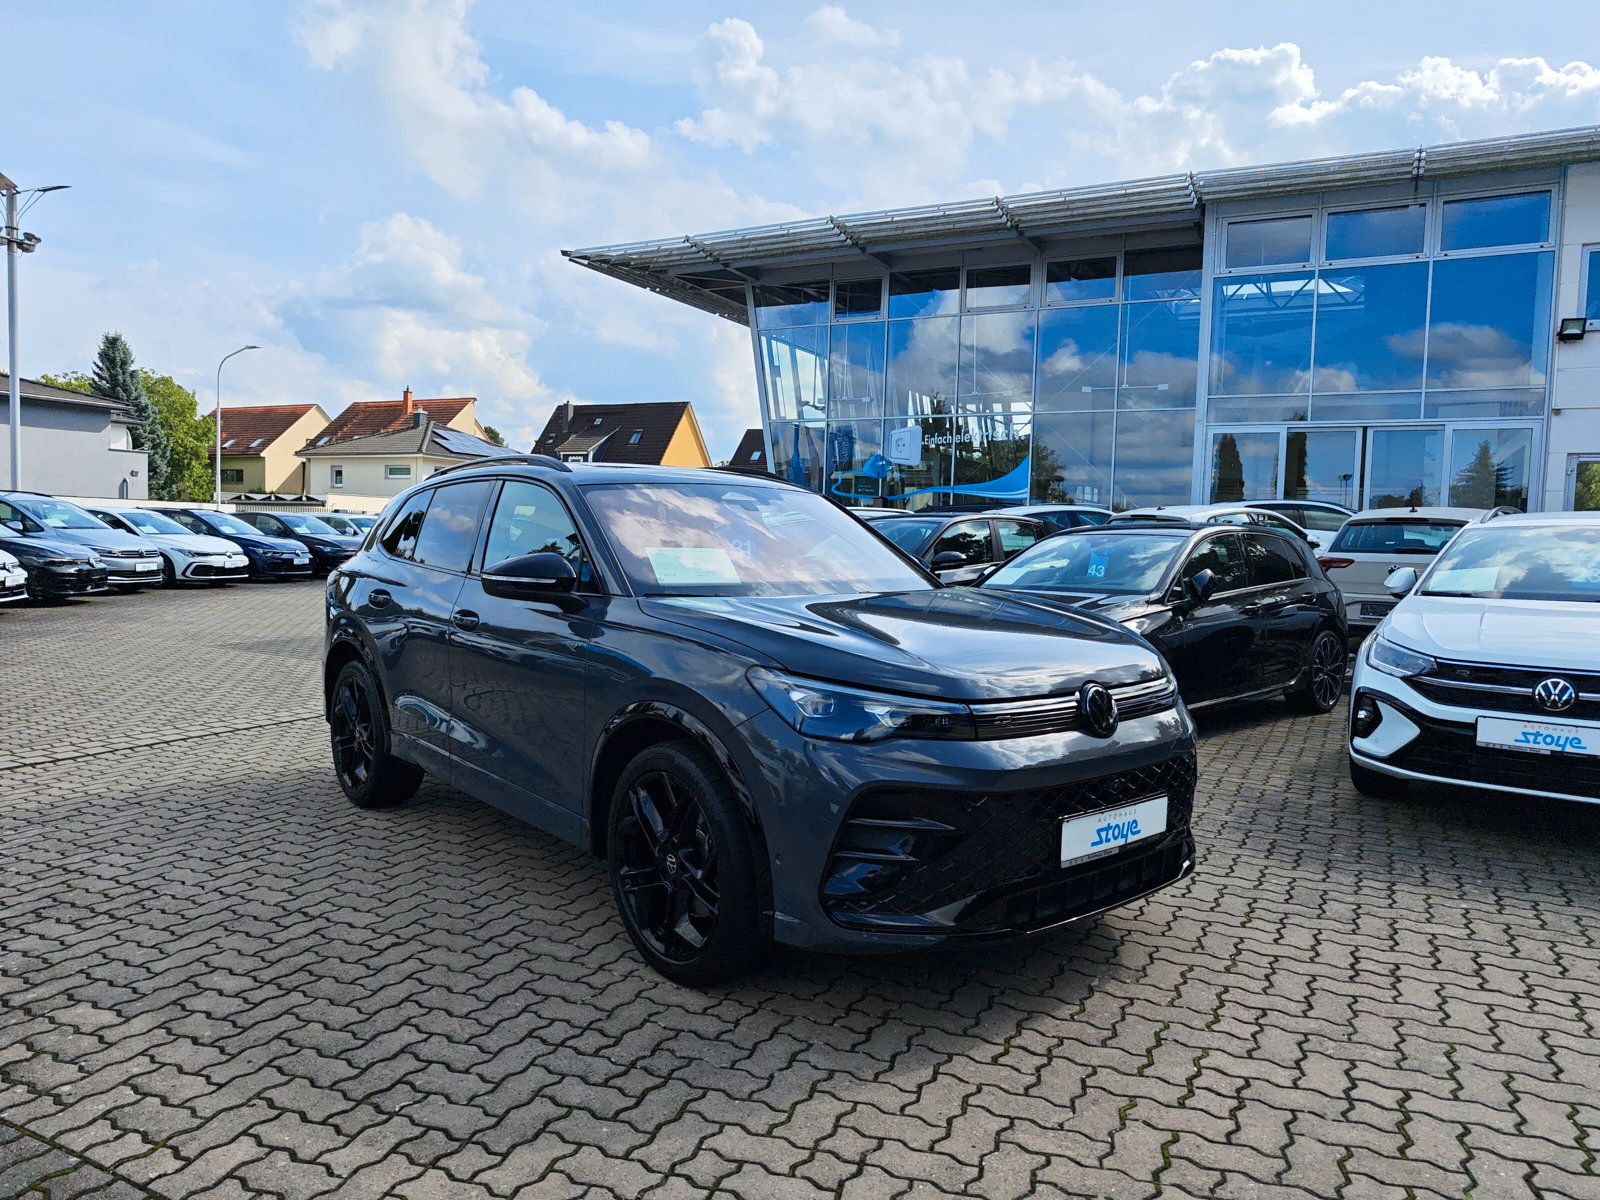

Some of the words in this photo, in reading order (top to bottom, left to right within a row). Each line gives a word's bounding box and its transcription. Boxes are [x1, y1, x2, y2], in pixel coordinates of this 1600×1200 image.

[1088, 565, 1105, 577] 43
[1523, 724, 1580, 734] AUTOHAUS
[1097, 808, 1137, 823] AUTOHAUS
